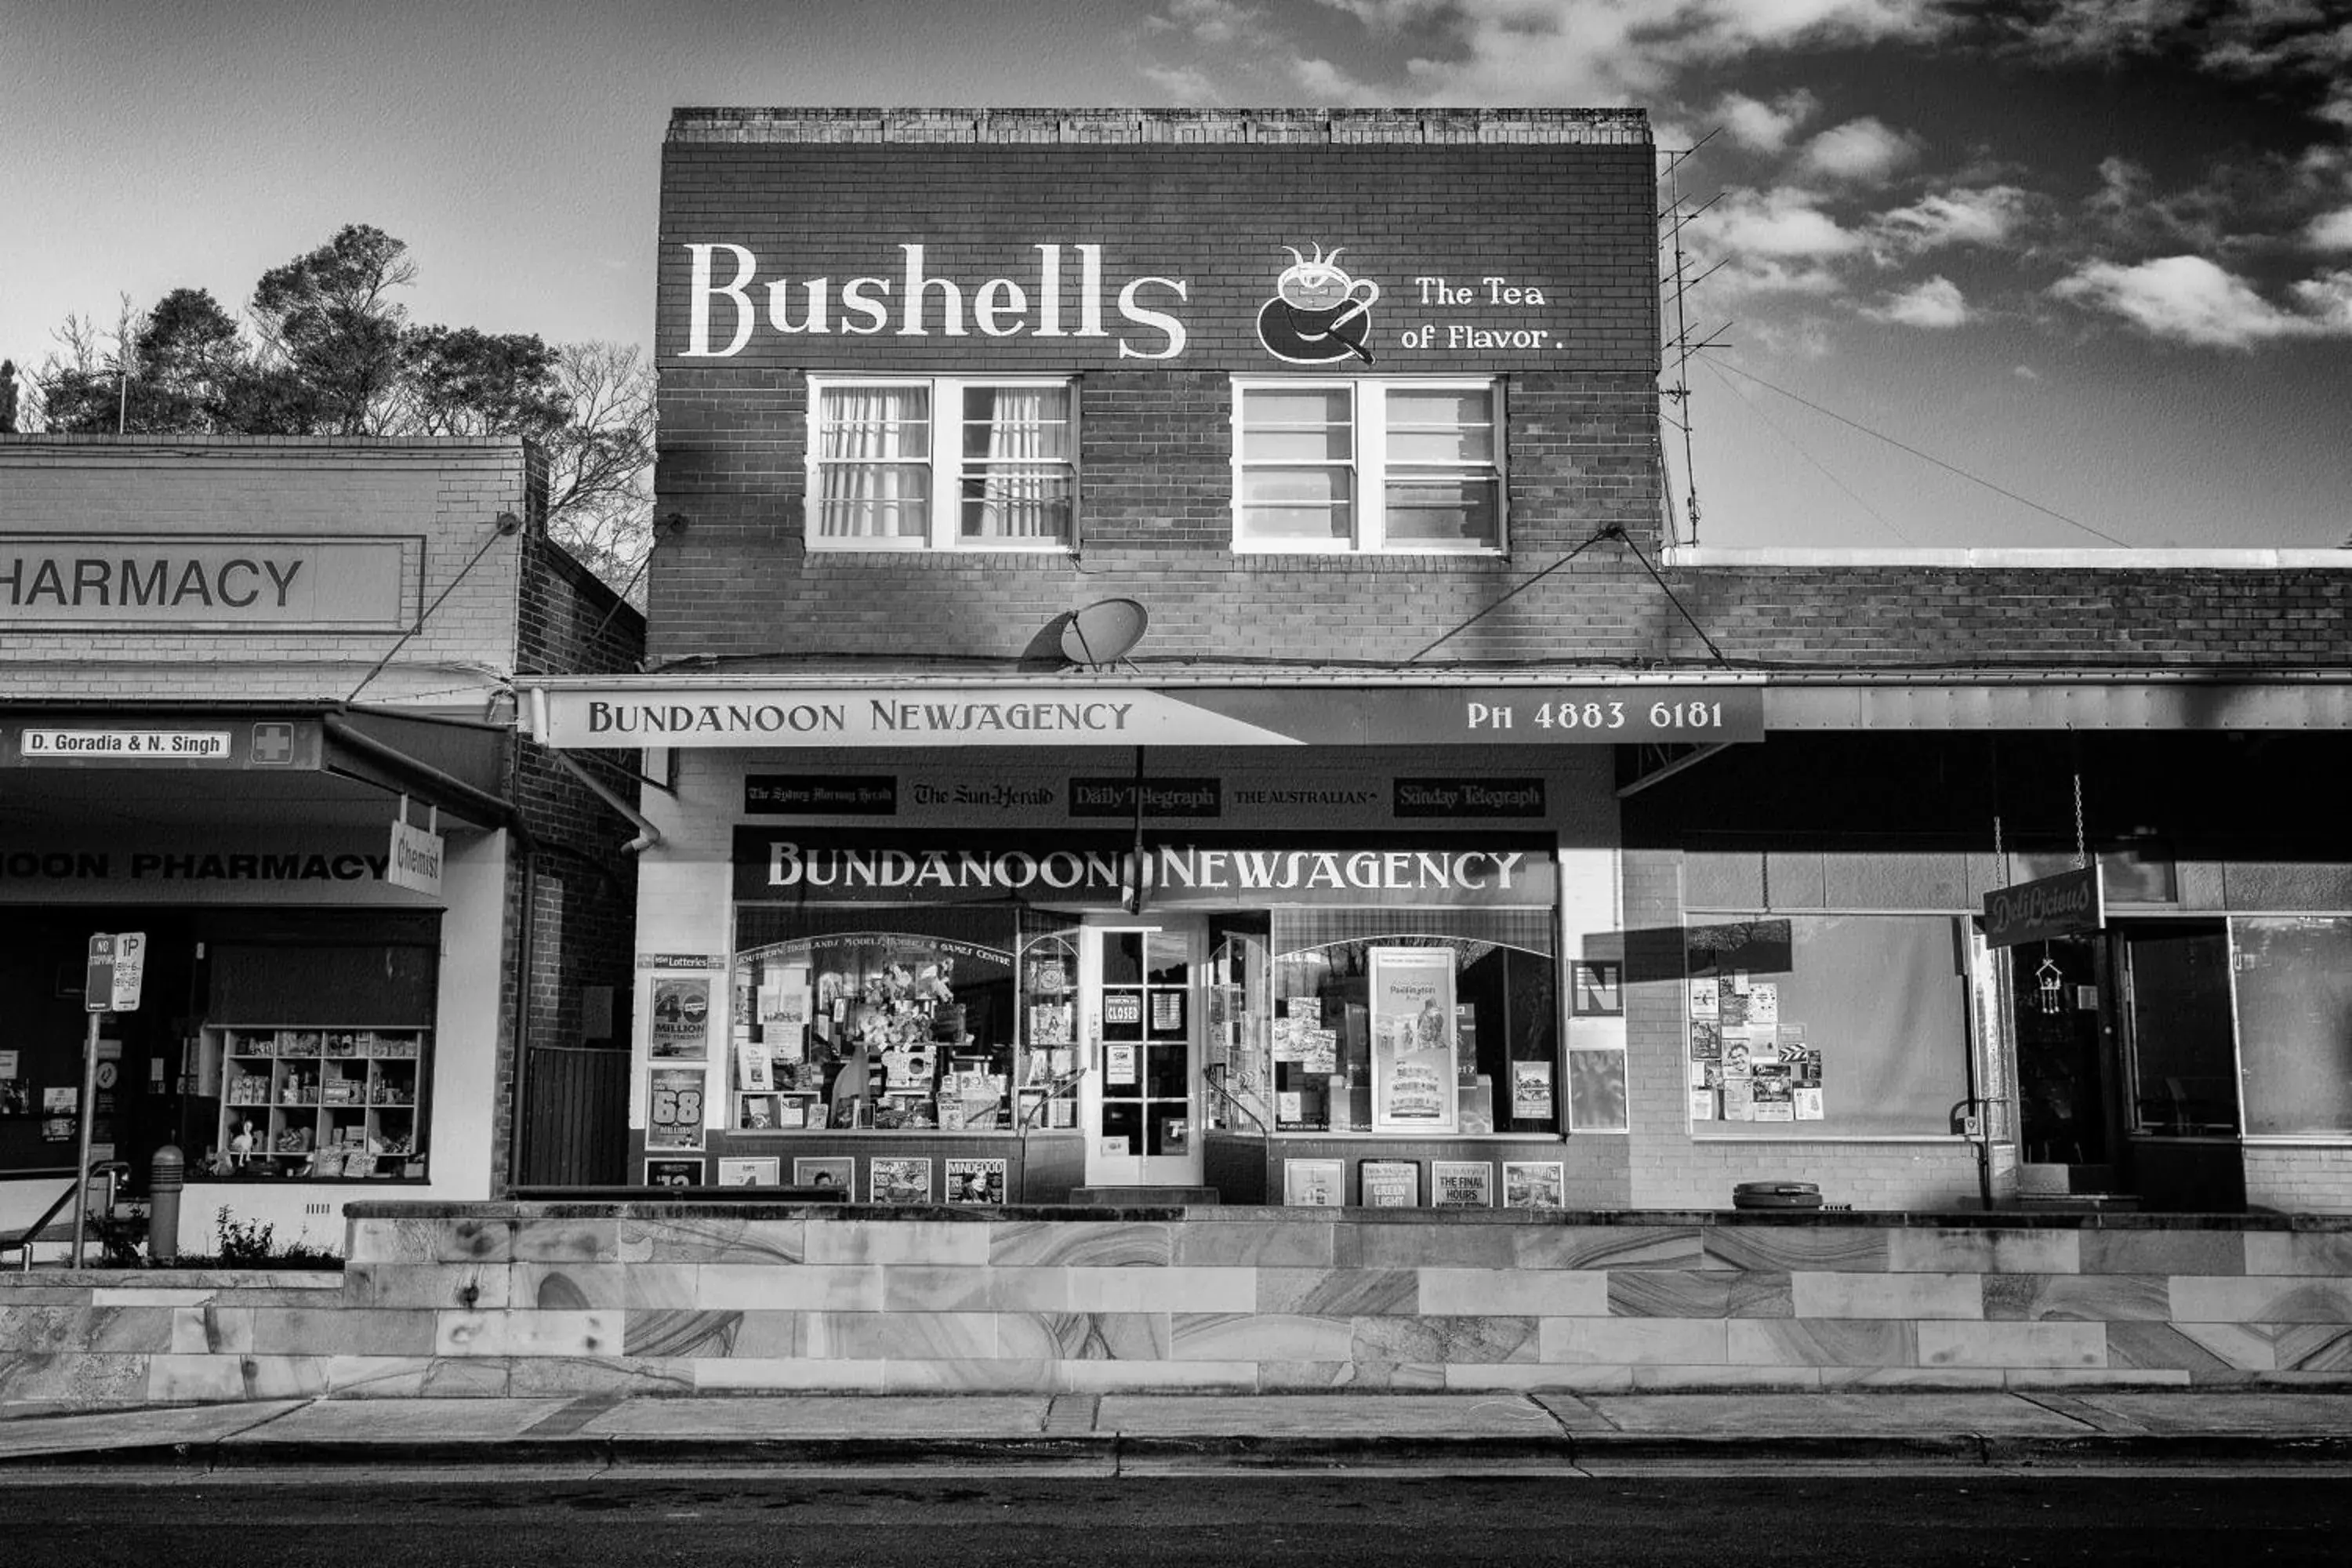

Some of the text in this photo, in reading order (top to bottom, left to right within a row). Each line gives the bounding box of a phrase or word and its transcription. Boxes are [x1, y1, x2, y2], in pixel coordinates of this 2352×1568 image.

[677, 244, 1187, 360] Bushells
[1415, 277, 1544, 306] The Tea
[1401, 325, 1436, 348] of
[589, 700, 1133, 732] BUNDANOON NEWSAGENCY
[1468, 702, 1722, 728] PH 4883 6181
[31, 734, 220, 755] D. Goradia & N. Singh
[913, 785, 947, 805] The
[1076, 786, 1123, 809] Daily
[1234, 791, 1266, 805] THE
[1399, 786, 1540, 810] Sunday Telegraph
[131, 853, 389, 880] PHARMACY
[397, 837, 438, 879] Chemist
[768, 841, 1523, 890] BUNDANOON NEWSAGENCY
[97, 941, 109, 953] NO
[123, 938, 138, 956] 1P
[669, 956, 707, 967] Lotteries
[1108, 1006, 1138, 1020] CLOSED
[655, 1023, 704, 1033] MILLION
[652, 1089, 702, 1124] 68
[1374, 1184, 1406, 1196] GREEN
[1439, 1177, 1484, 1189] THE FINAL
[1446, 1189, 1479, 1201] HOURS
